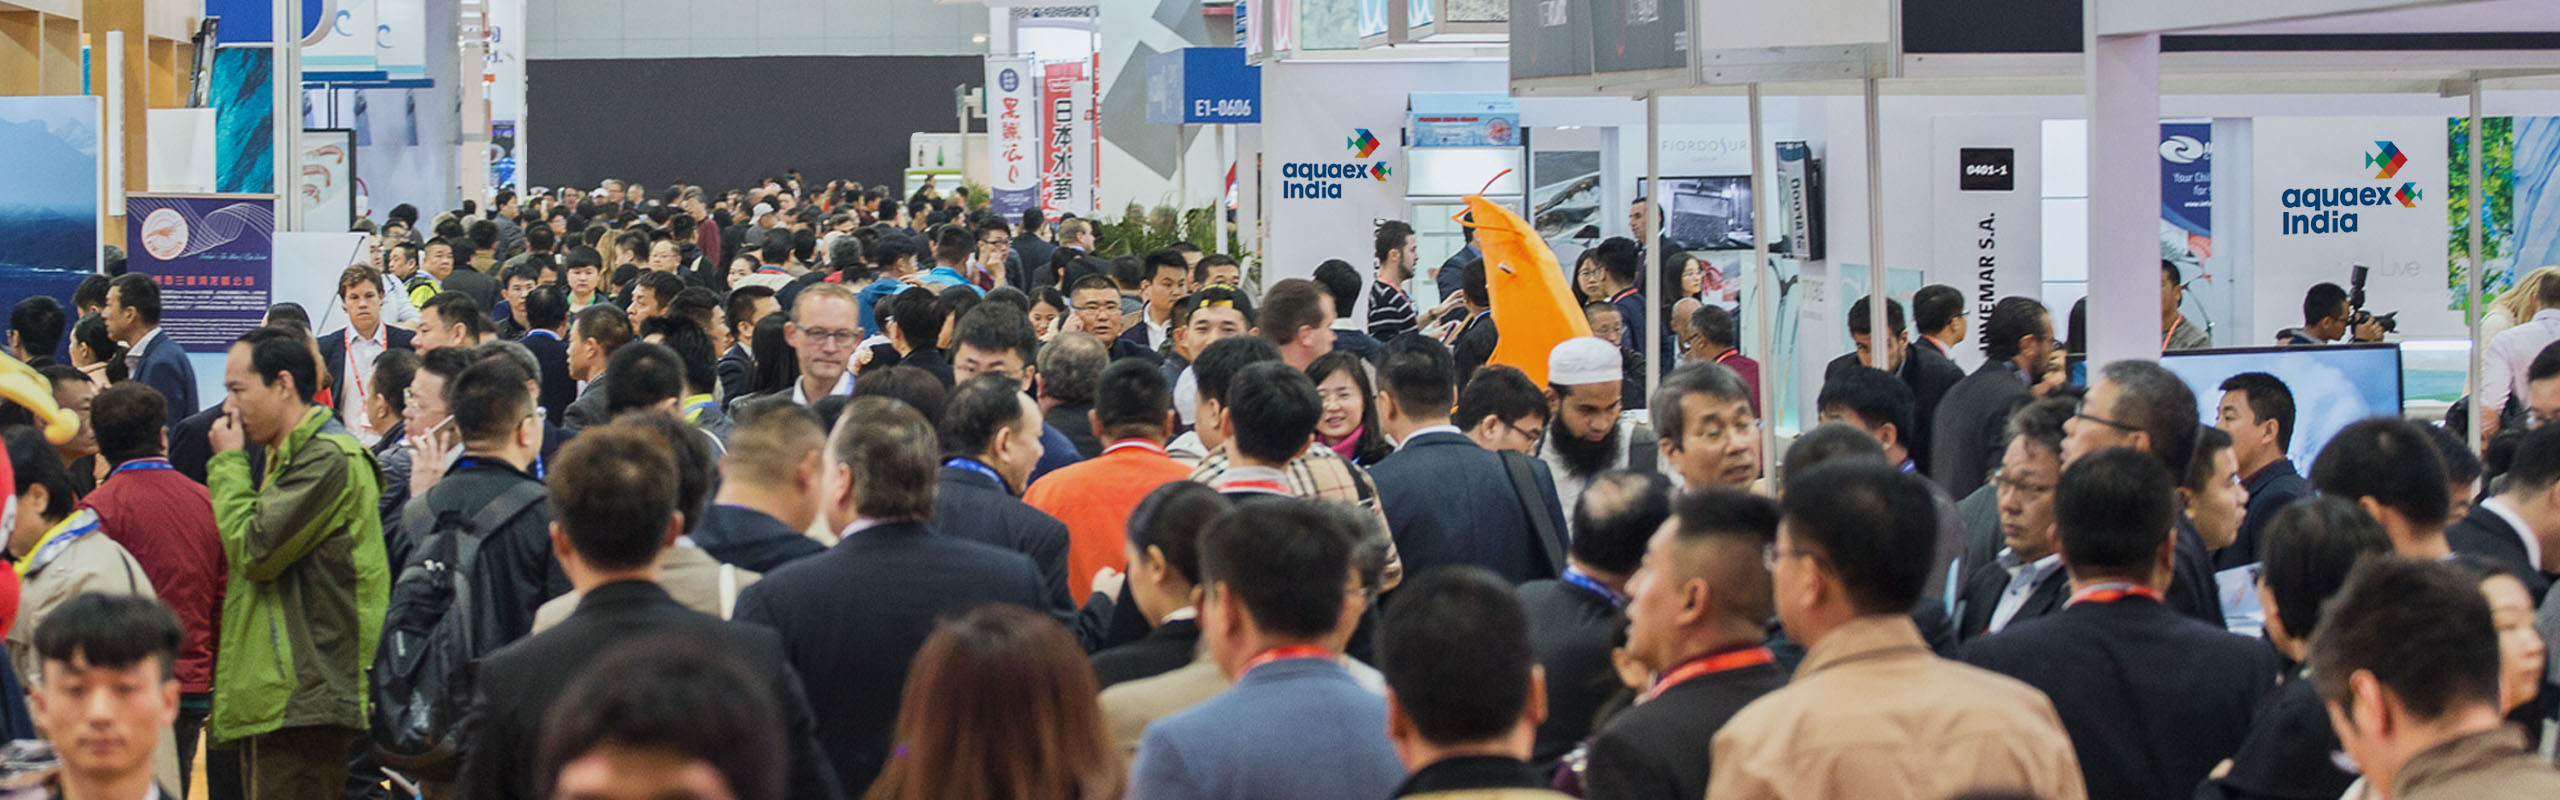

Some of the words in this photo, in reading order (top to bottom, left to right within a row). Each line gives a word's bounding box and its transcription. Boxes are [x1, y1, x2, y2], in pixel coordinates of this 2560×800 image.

[1194, 99, 1252, 117] E1-0606
[1282, 162, 1368, 181] aquaex
[1966, 164, 2008, 176] 0401-1
[1283, 180, 1342, 199] India
[2281, 187, 2392, 211] aquaex
[1978, 212, 1996, 249] S.A.
[2283, 210, 2358, 235] India
